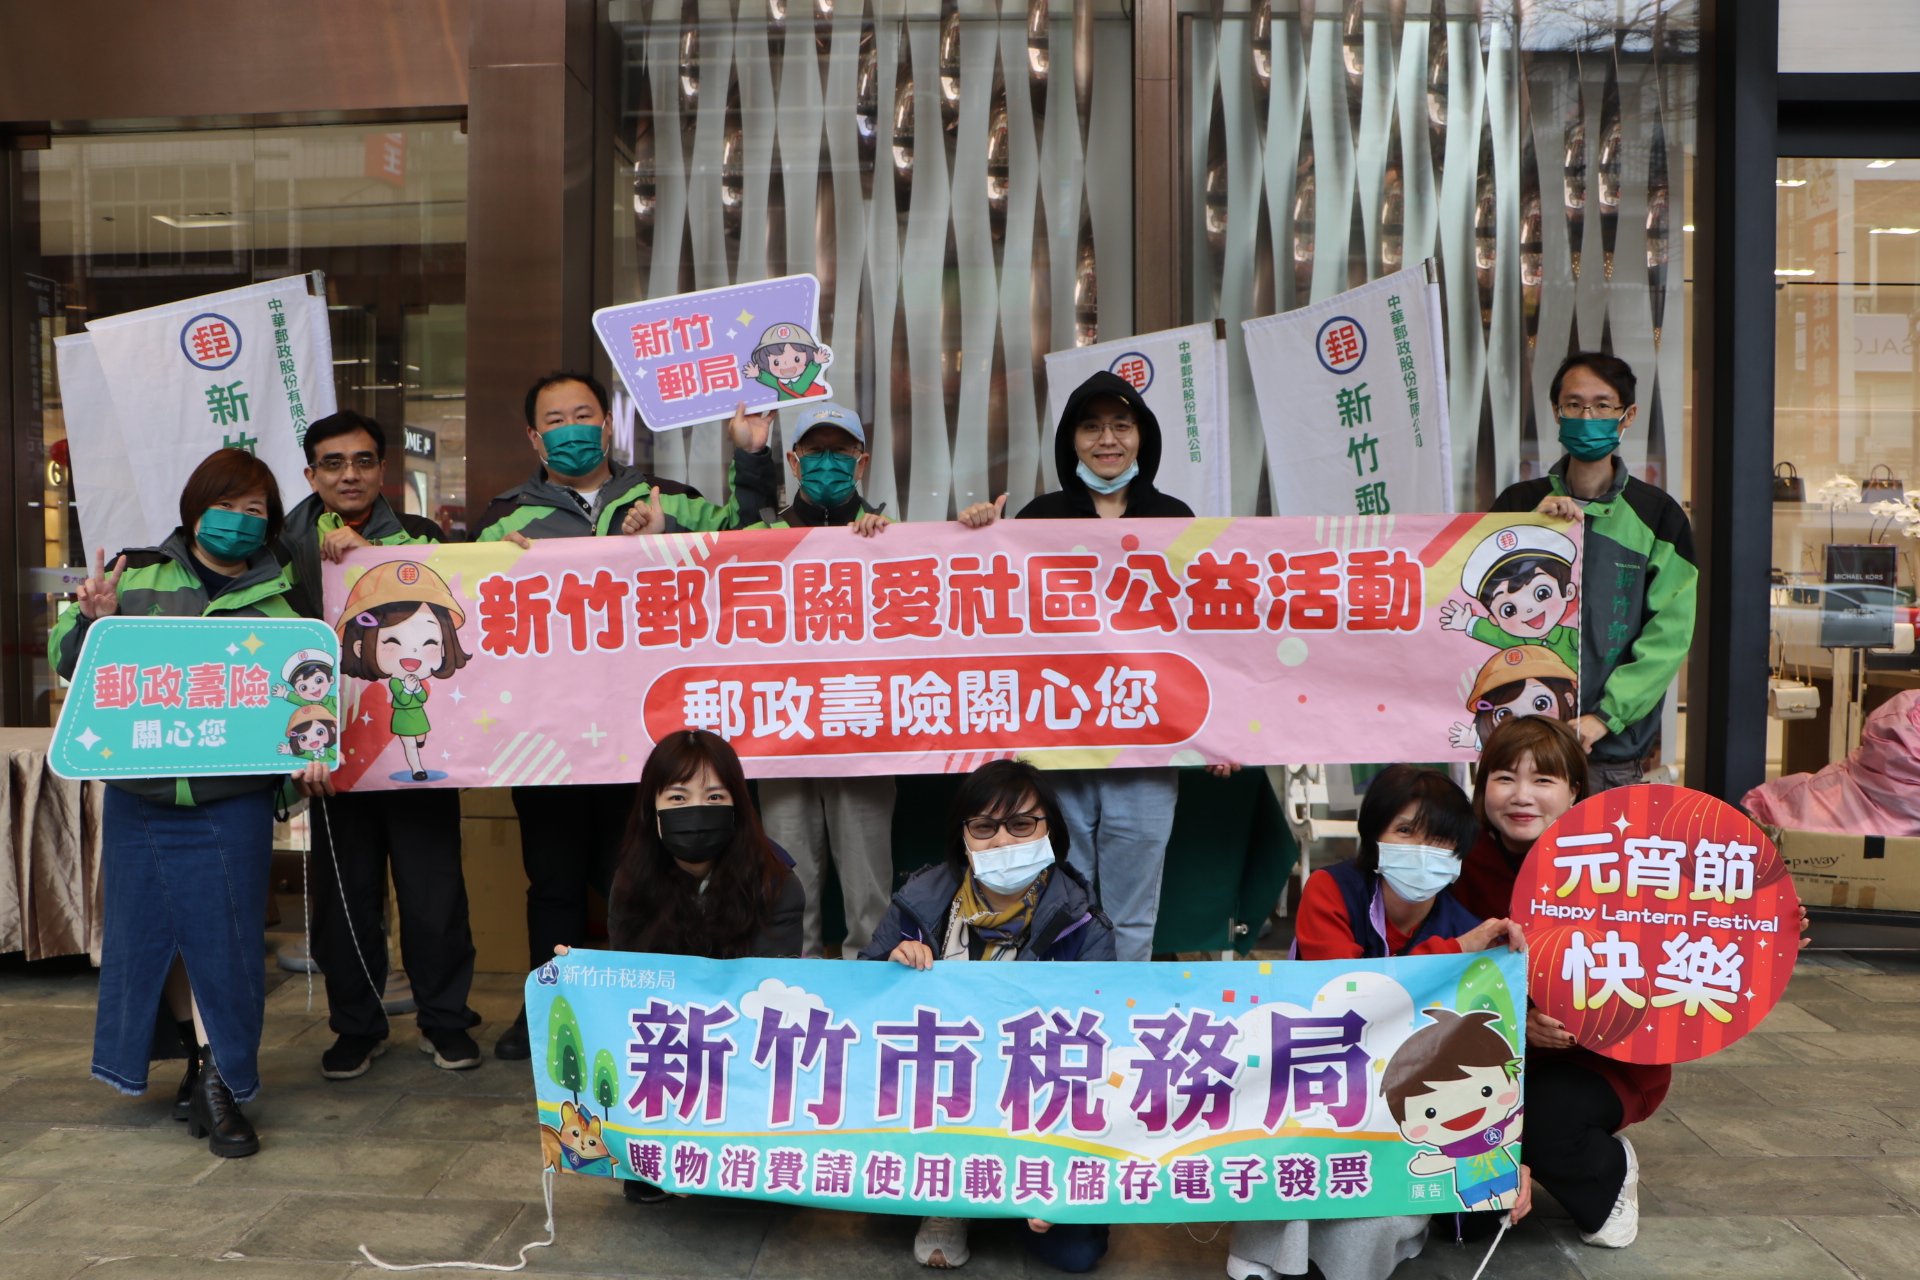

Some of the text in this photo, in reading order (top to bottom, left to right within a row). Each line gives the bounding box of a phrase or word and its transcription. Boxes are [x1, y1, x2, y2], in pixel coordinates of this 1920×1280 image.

[631, 313, 713, 360] 新竹
[656, 353, 742, 403] 郵局
[1179, 341, 1202, 463] 中華郵政股份有限公司
[1387, 295, 1423, 448] 中華郵政股份有限公司
[480, 547, 1425, 657] 新竹郵局關愛社區公益活動
[94, 662, 271, 710] 郵政壽險
[683, 666, 1160, 742] 郵政壽險關心您
[132, 719, 227, 749] 關心您
[1553, 832, 1758, 904] 元宵節
[1530, 899, 1779, 932] Happy Lantern Festival
[1561, 931, 1744, 1023] 快樂
[627, 1140, 1371, 1202] 購物消費請使用載具儲存電子發票
[1412, 1183, 1442, 1199] 廣告
